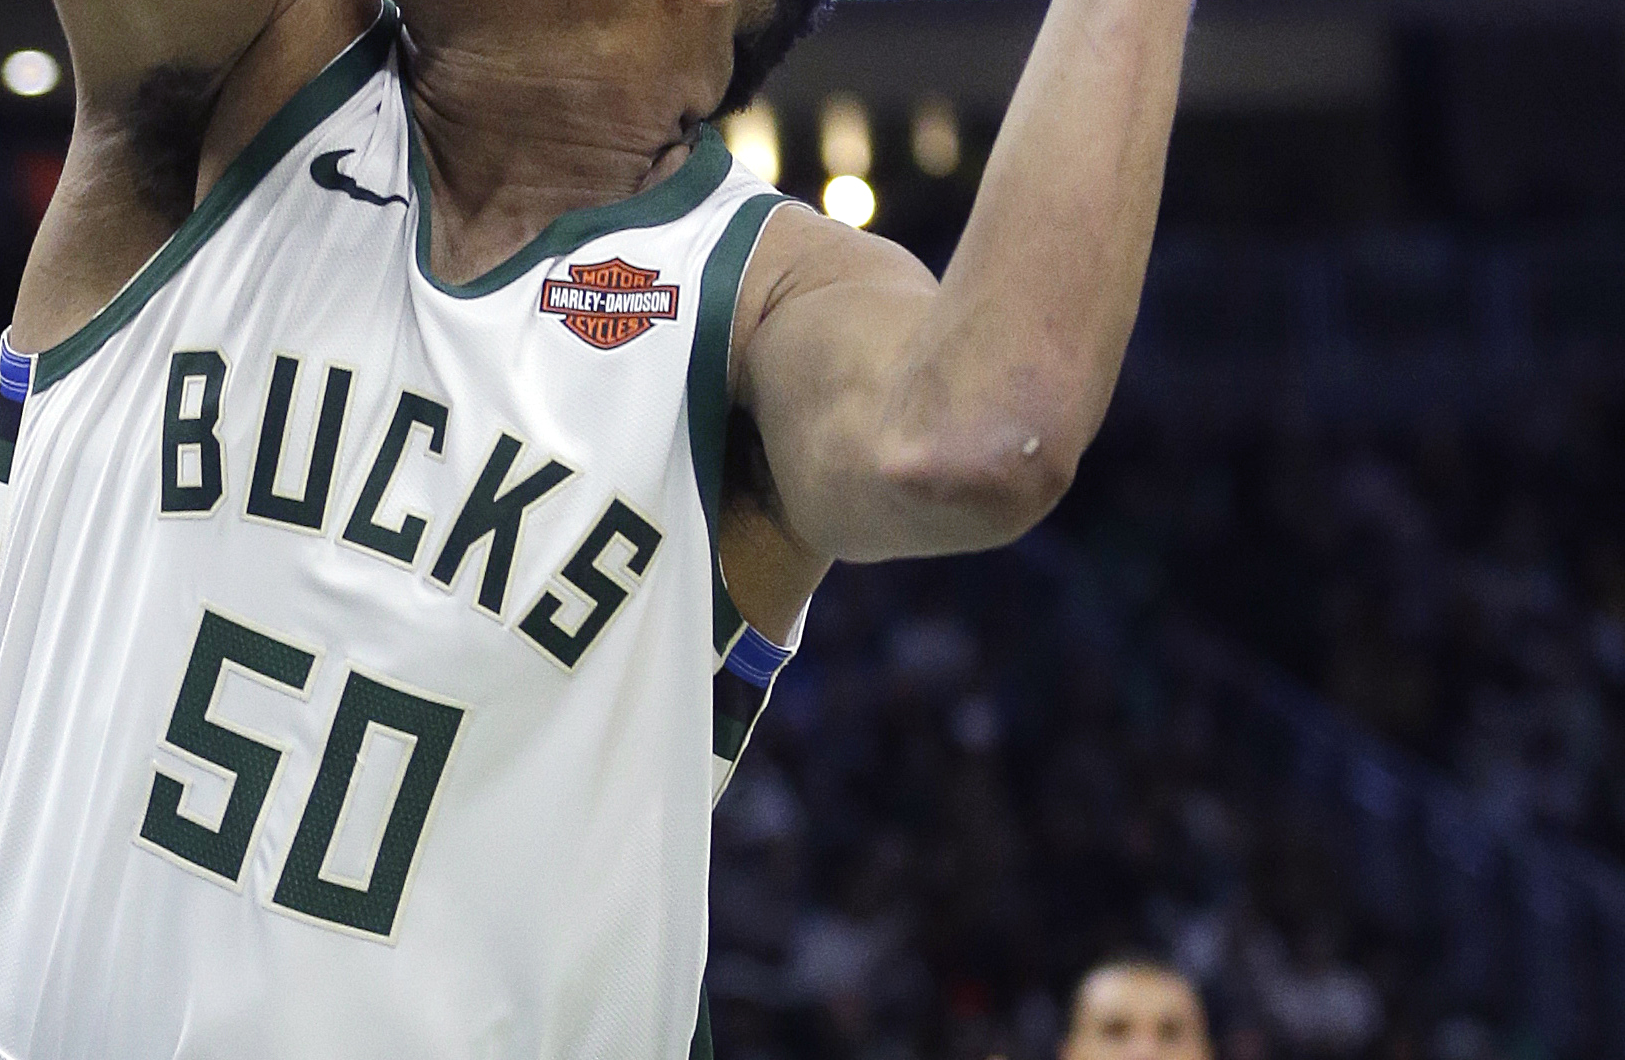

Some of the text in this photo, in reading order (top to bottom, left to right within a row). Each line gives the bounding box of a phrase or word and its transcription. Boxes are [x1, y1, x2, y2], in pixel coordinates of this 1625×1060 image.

[581, 266, 646, 289] MOTOR
[549, 285, 671, 314] HARLEY-DAVIDSON
[575, 315, 640, 344] CYCLES
[158, 348, 667, 675] BUCKS
[134, 599, 473, 947] 50
